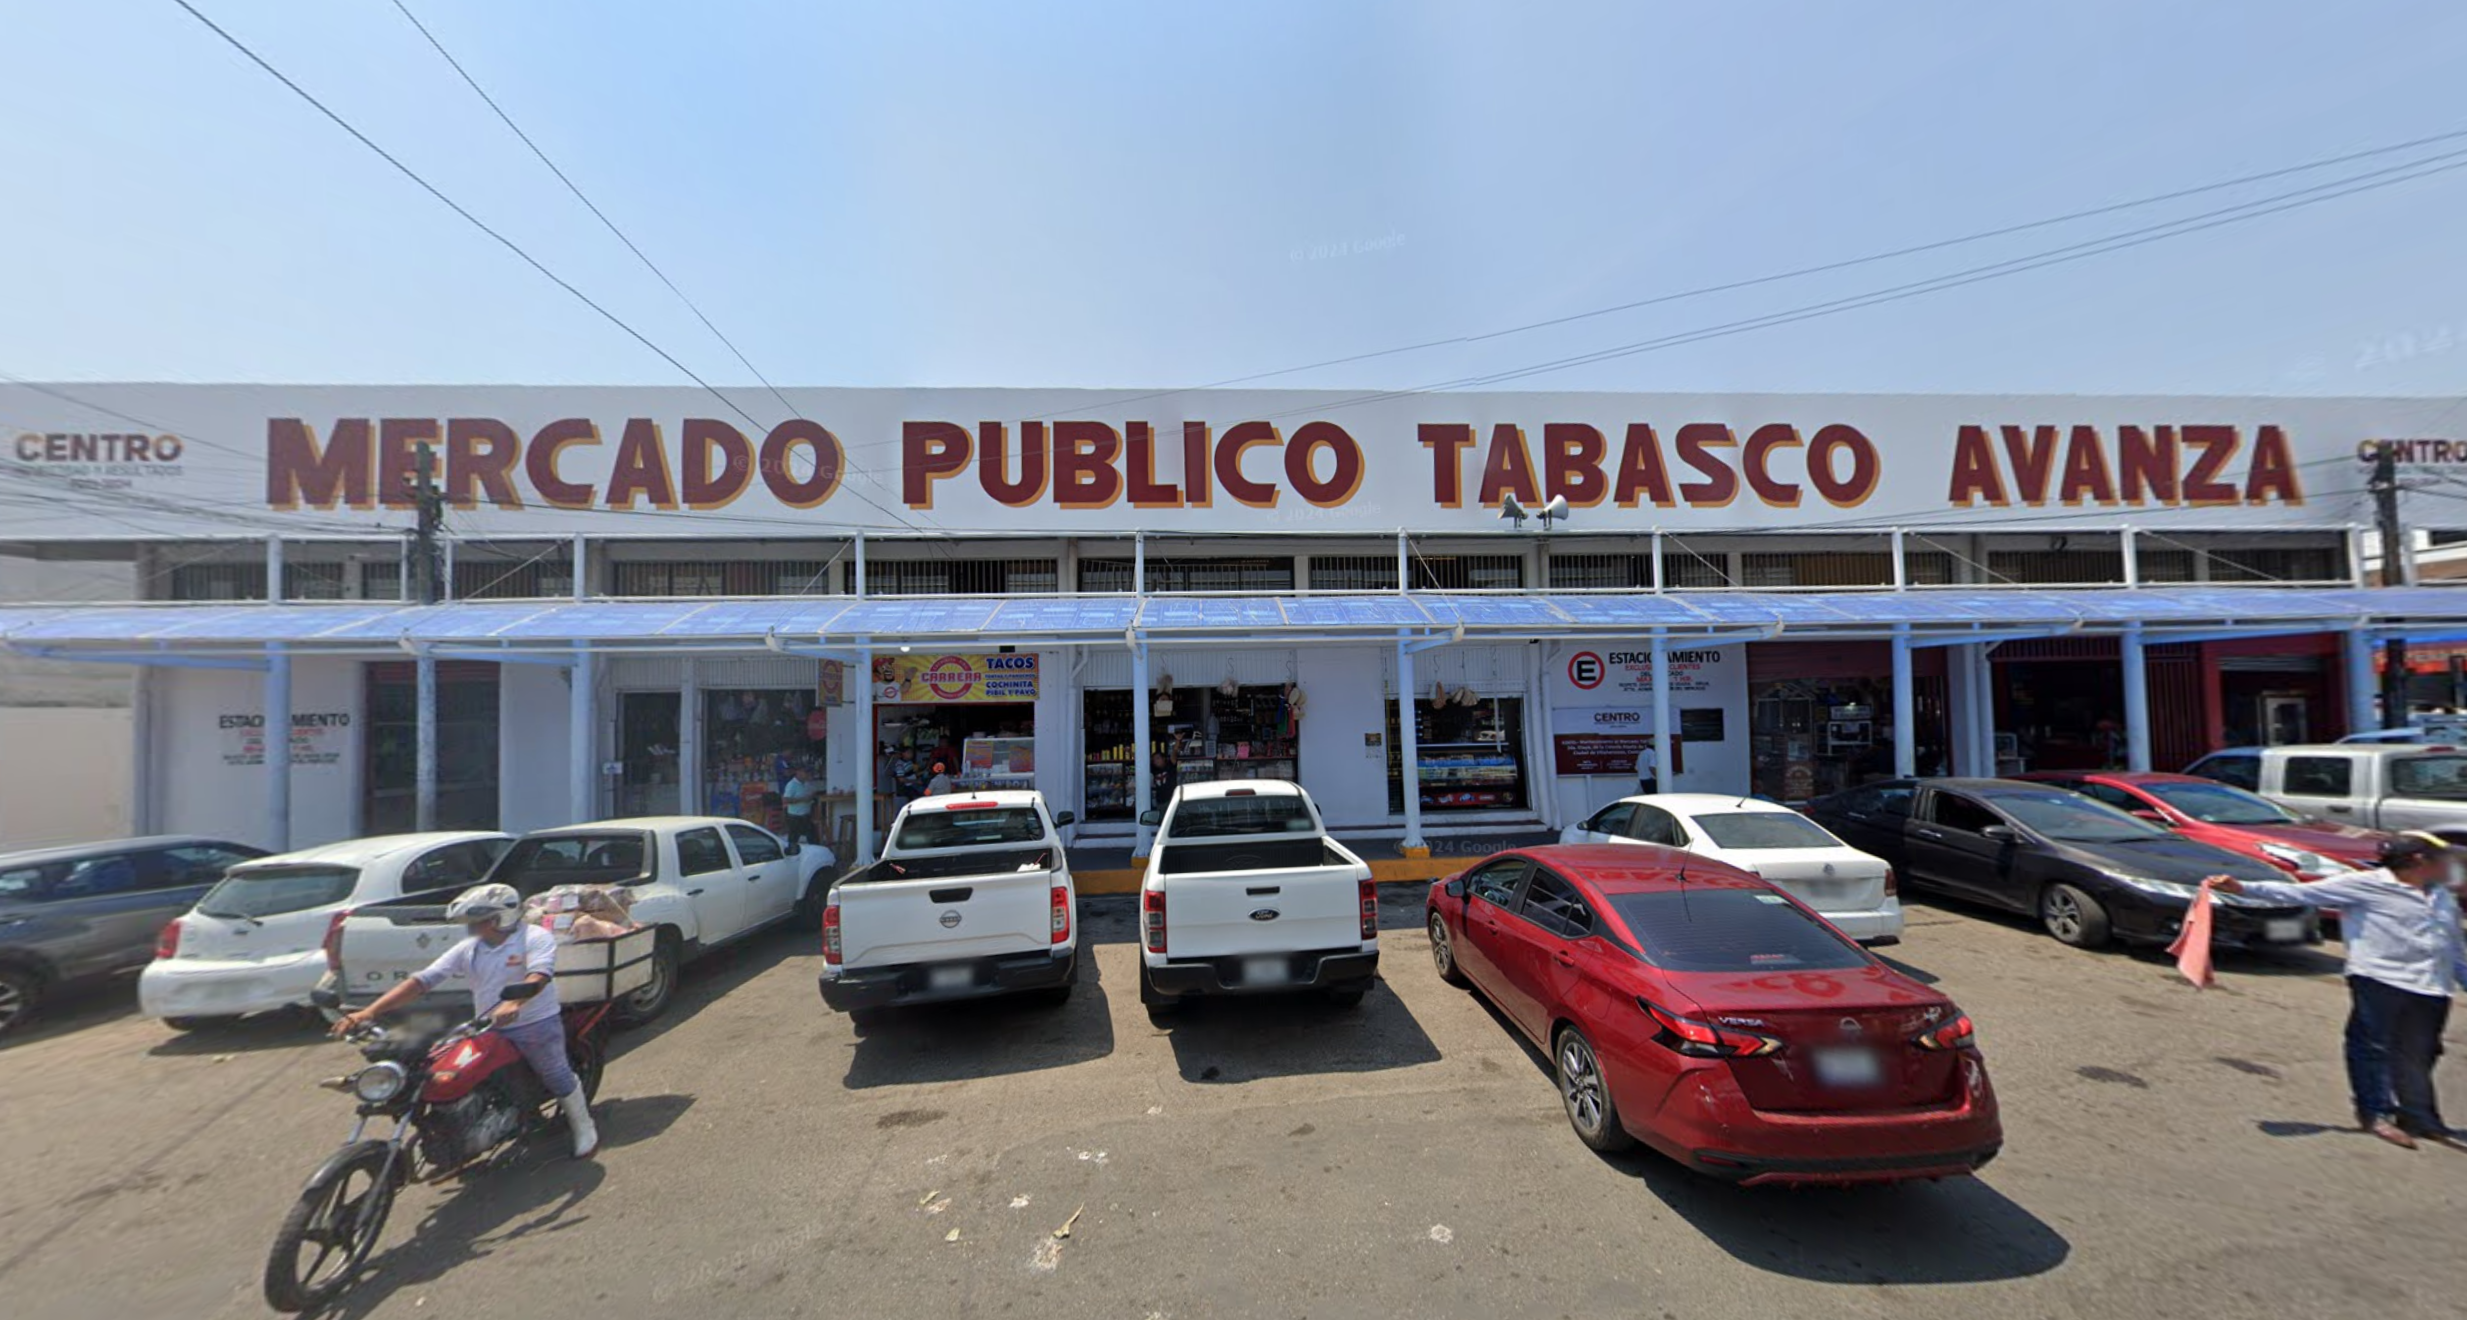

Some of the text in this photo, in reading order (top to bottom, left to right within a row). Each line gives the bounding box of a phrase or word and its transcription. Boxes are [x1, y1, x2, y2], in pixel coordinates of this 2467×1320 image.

[16, 433, 184, 462] CENTRO
[267, 417, 2304, 511] MERCADO PUBLICO TABASCO AVANZA
[986, 657, 1034, 669] TACOS
[1609, 651, 1721, 664] ESTACIOAMIENTO
[1577, 661, 1596, 681] E
[921, 672, 982, 683] CARRERA
[986, 680, 1034, 688] COCHINITA
[986, 688, 1037, 696] PIBIL Y PAVO
[1594, 712, 1641, 722] CENTRO
[1719, 1016, 1764, 1026] VERSA
